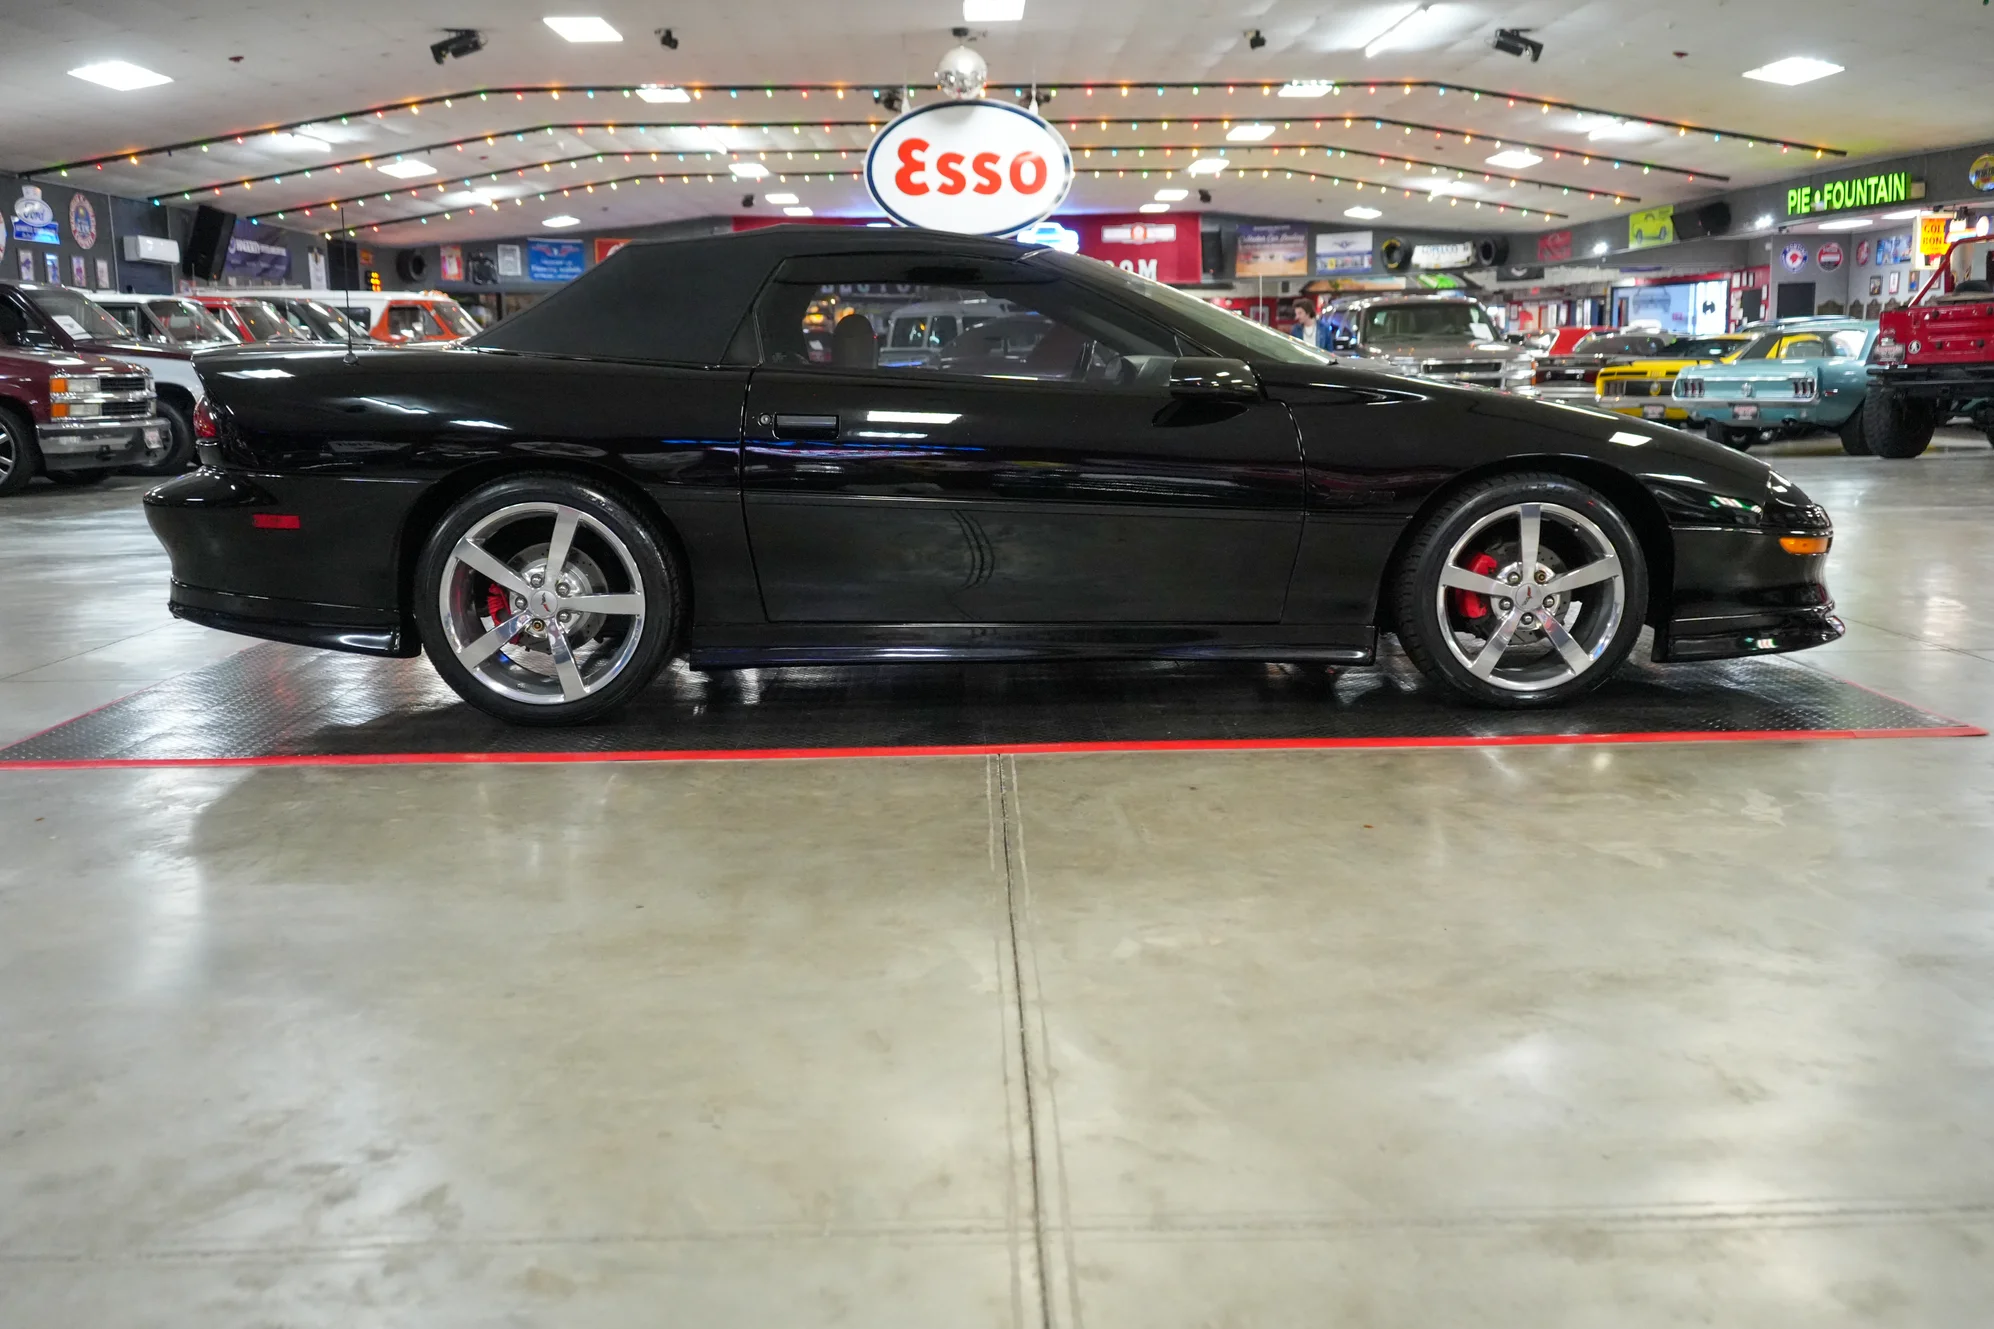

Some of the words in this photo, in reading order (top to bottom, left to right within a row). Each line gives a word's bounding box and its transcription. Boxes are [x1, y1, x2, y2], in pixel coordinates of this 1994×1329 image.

[895, 138, 1047, 196] Esso
[1787, 186, 1811, 215] PIE
[1823, 172, 1906, 211] FOUNTAIN
